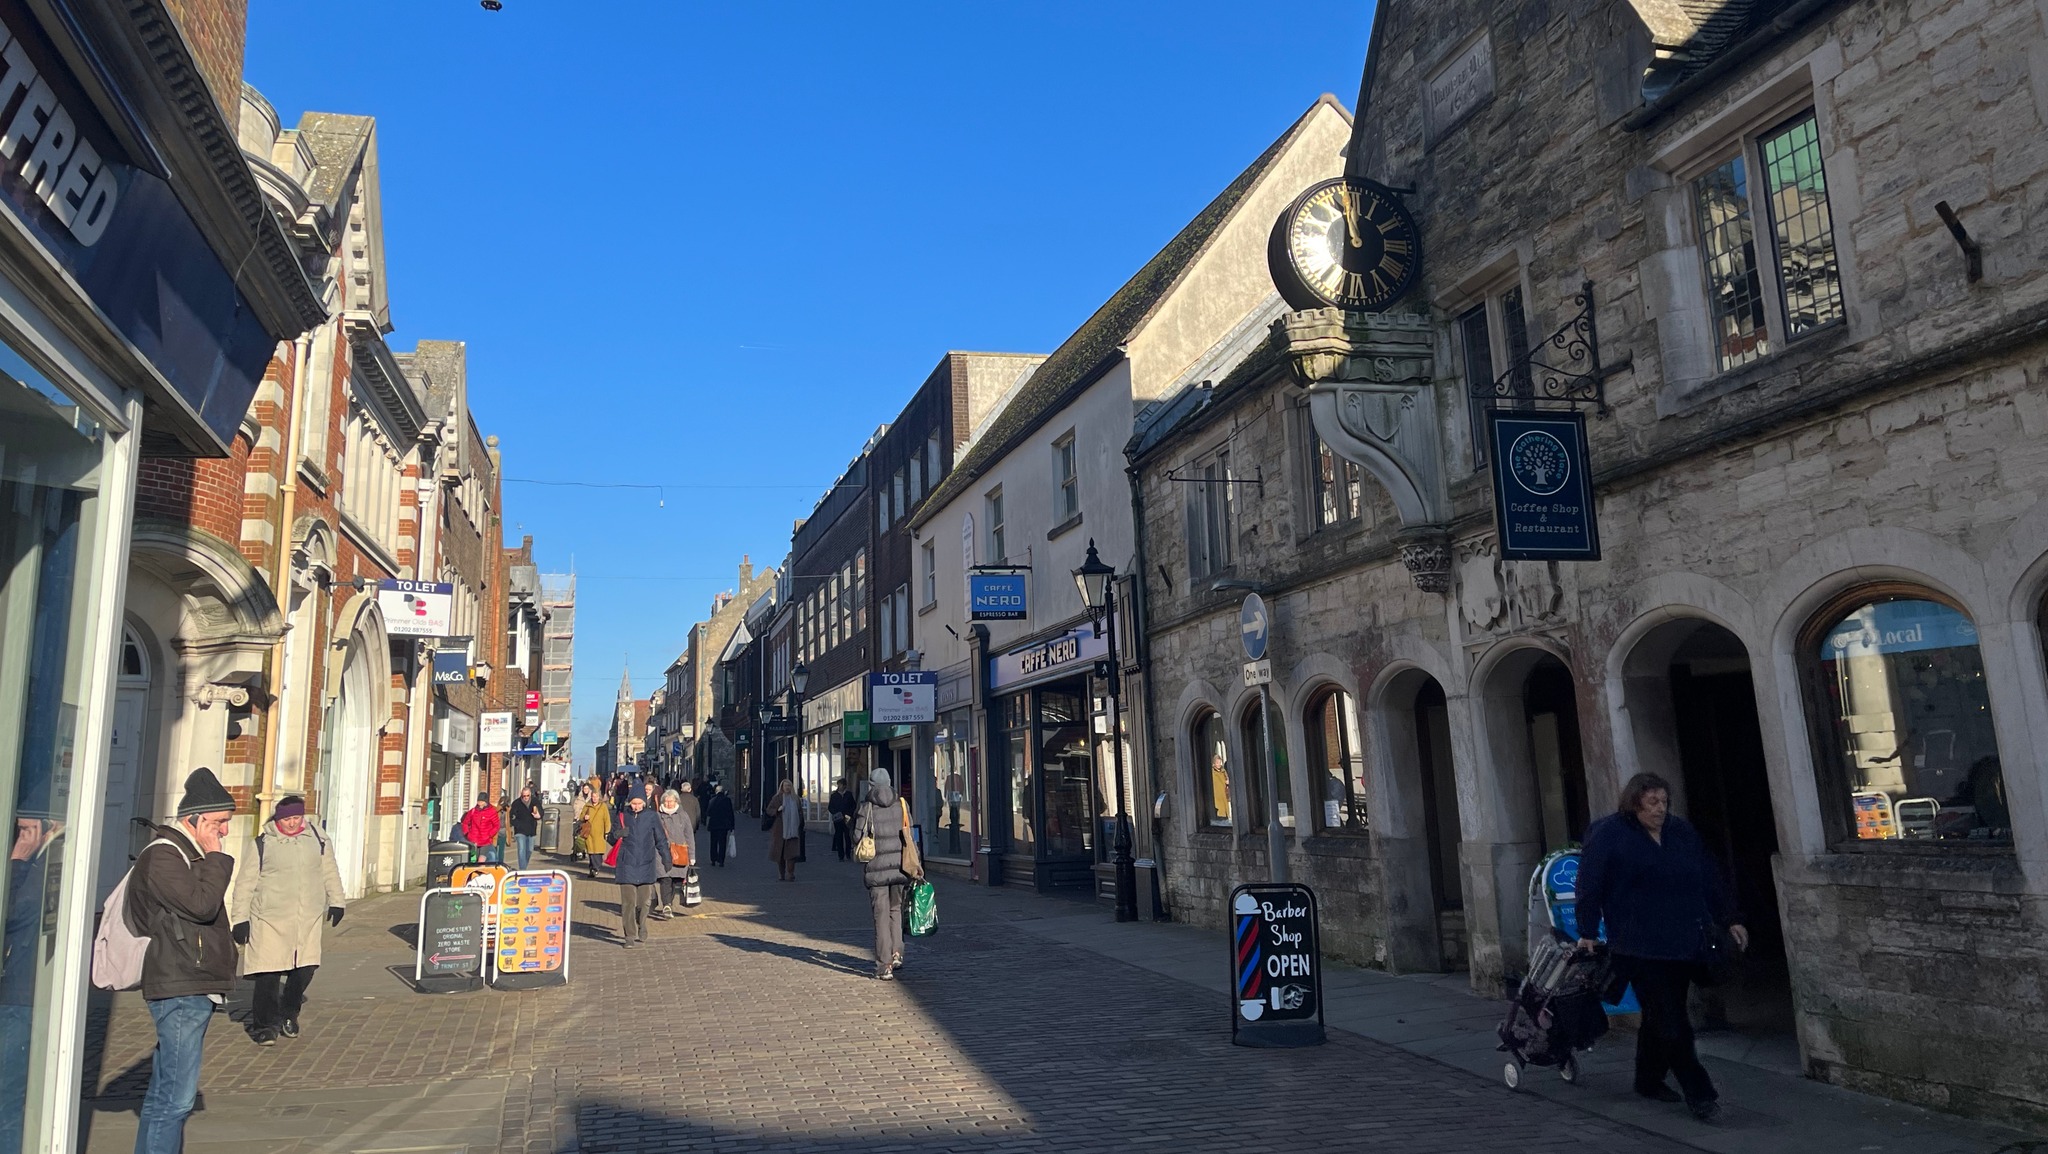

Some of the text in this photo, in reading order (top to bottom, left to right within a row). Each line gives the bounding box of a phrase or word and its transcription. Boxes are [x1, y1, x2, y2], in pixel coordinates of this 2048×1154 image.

[0, 17, 118, 247] TFRED
[1515, 435, 1559, 453] Gathering
[1555, 452, 1566, 479] Place
[1510, 502, 1579, 515] Coffee Shop
[1539, 514, 1548, 523] &
[1514, 523, 1580, 534] Restaurant
[396, 580, 437, 592] TO LET
[976, 595, 1022, 606] NERO
[428, 619, 444, 627] BAS
[1872, 623, 1923, 646] Local
[1020, 637, 1076, 674] CAFFE NERO
[882, 672, 923, 684] TO LET
[1245, 667, 1269, 680] One way
[1261, 900, 1307, 922] Barber
[436, 925, 472, 934] DORCHESTER'S
[1270, 924, 1302, 949] Shop
[1267, 953, 1310, 978] OPEN
